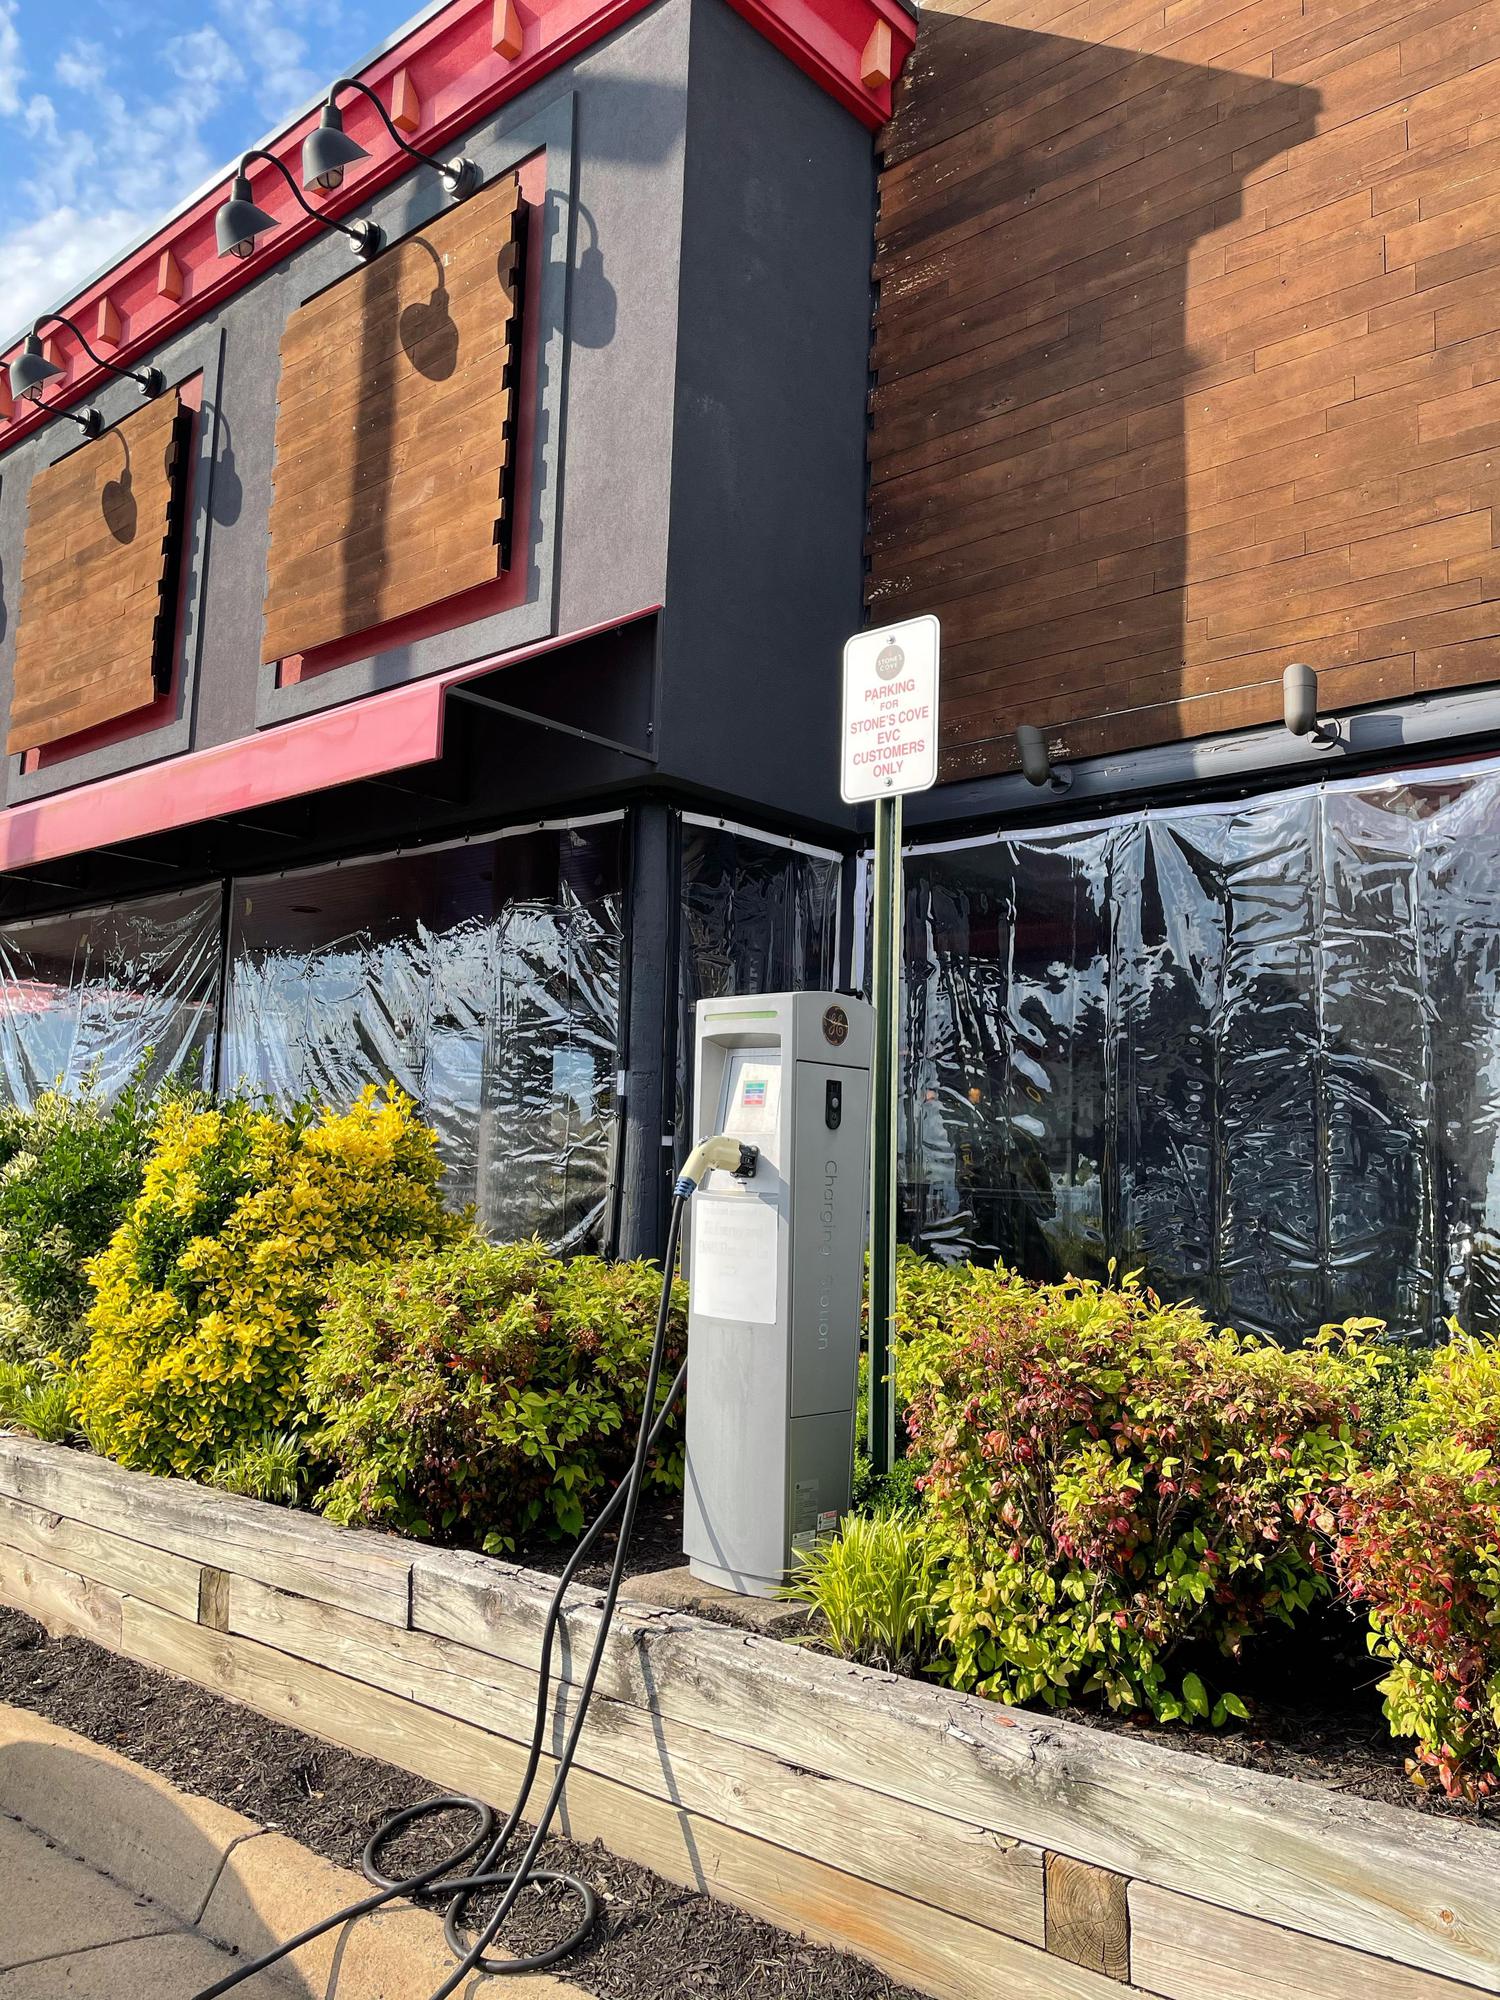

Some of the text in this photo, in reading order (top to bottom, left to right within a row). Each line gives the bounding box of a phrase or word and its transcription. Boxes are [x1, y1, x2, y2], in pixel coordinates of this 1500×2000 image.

[864, 678, 916, 702] PARKING
[880, 699, 899, 711] FOR
[850, 706, 929, 735] STONE'S COVE
[877, 729, 901, 745] EVC
[853, 739, 925, 766] CUSTOMERS
[873, 760, 904, 778] ONLY
[819, 1160, 838, 1256] Charging
